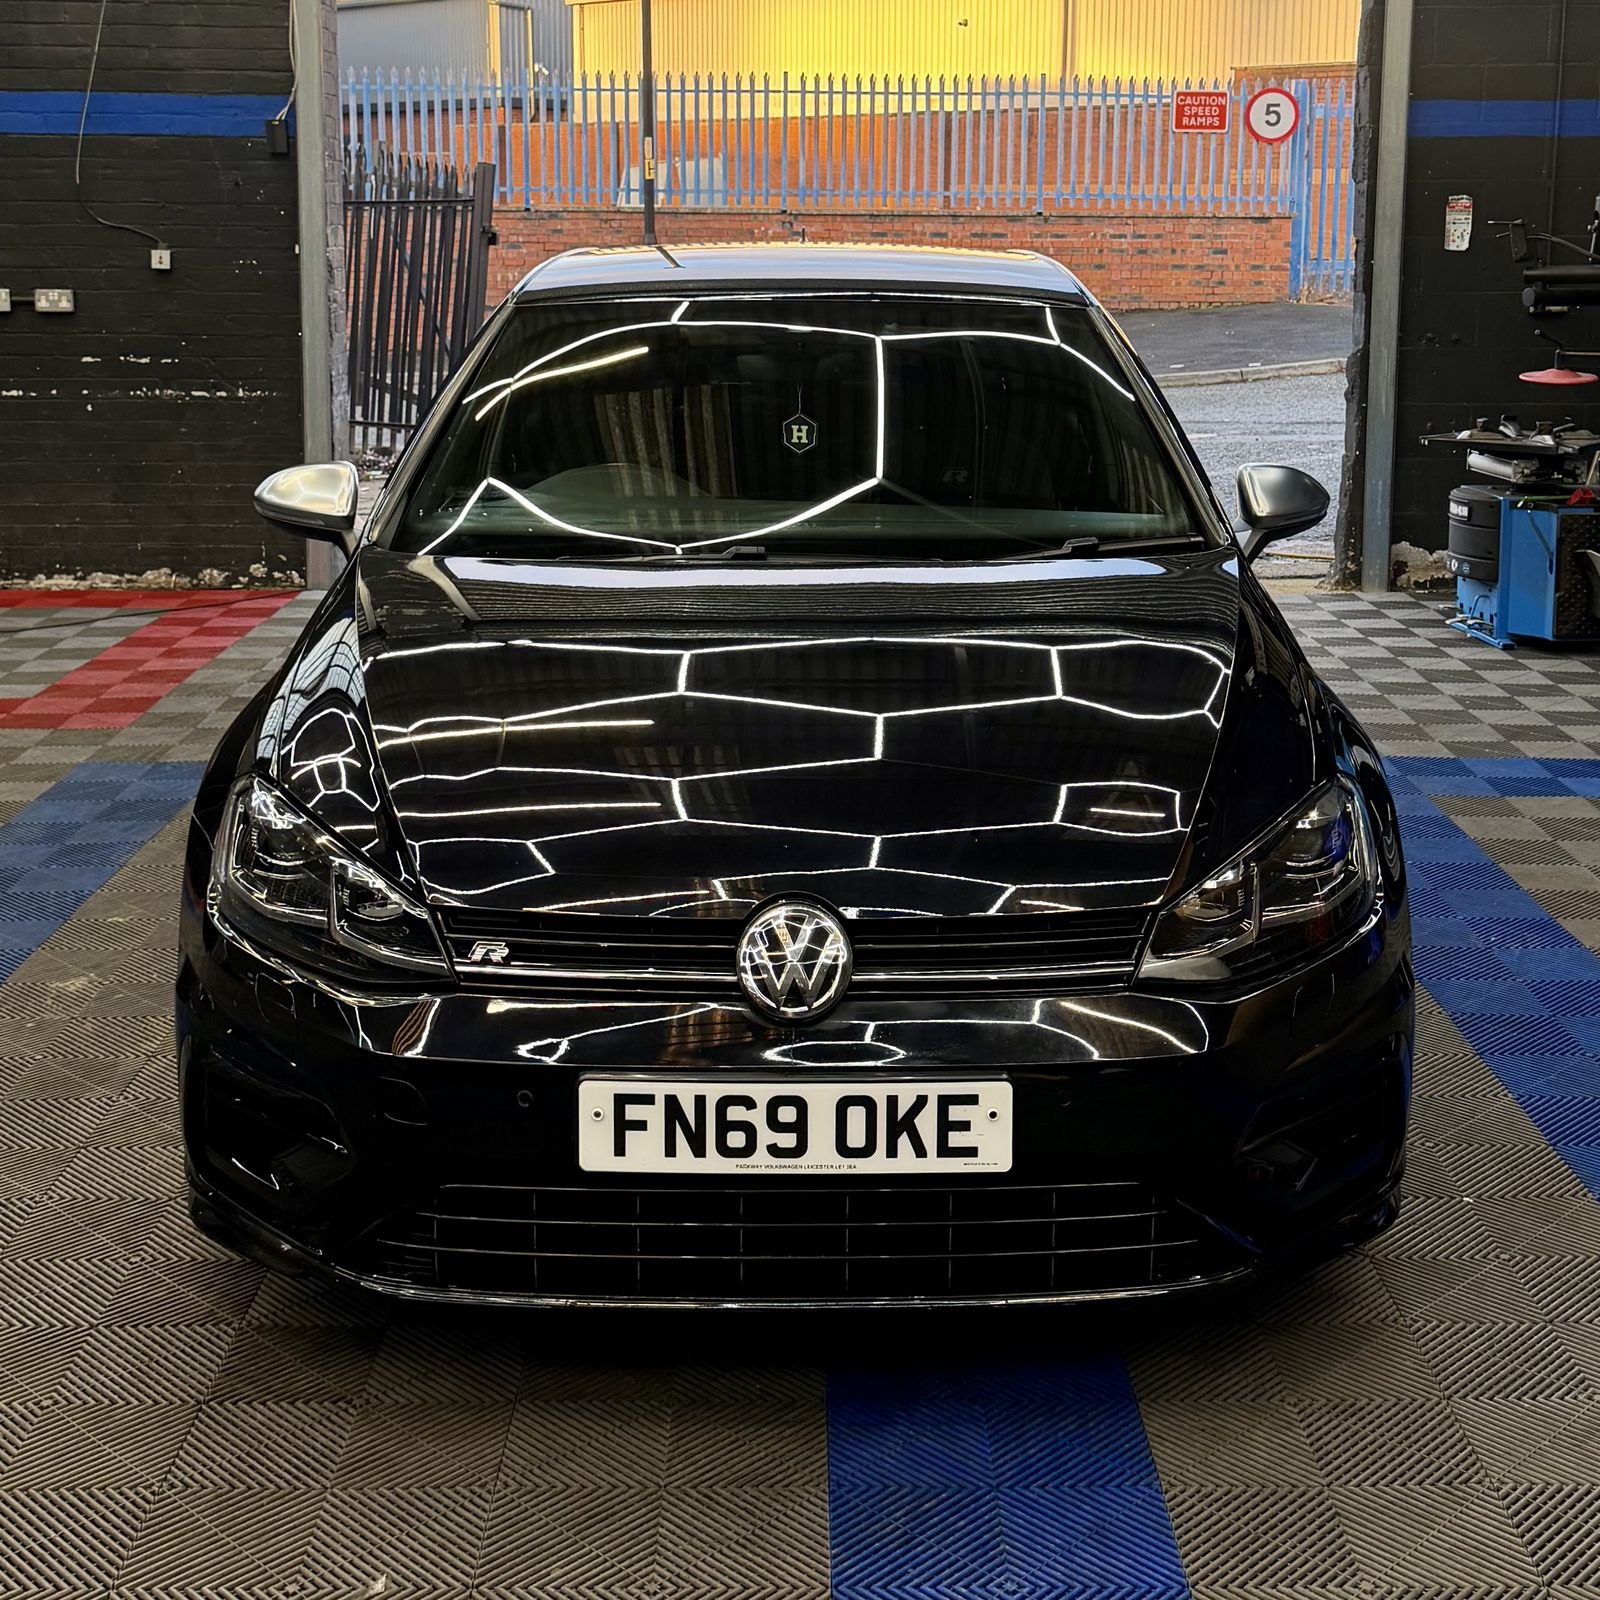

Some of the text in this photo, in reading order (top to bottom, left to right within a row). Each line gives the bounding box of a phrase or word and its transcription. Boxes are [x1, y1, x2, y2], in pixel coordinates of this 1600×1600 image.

[1177, 95, 1226, 105] CAUTION
[1182, 116, 1220, 126] RAMPS
[1183, 106, 1220, 116] SPEED
[1264, 103, 1282, 127] 5
[791, 425, 808, 443] H
[468, 941, 509, 963] R
[741, 905, 846, 1012] VW
[613, 1093, 979, 1159] FN69 OKE
